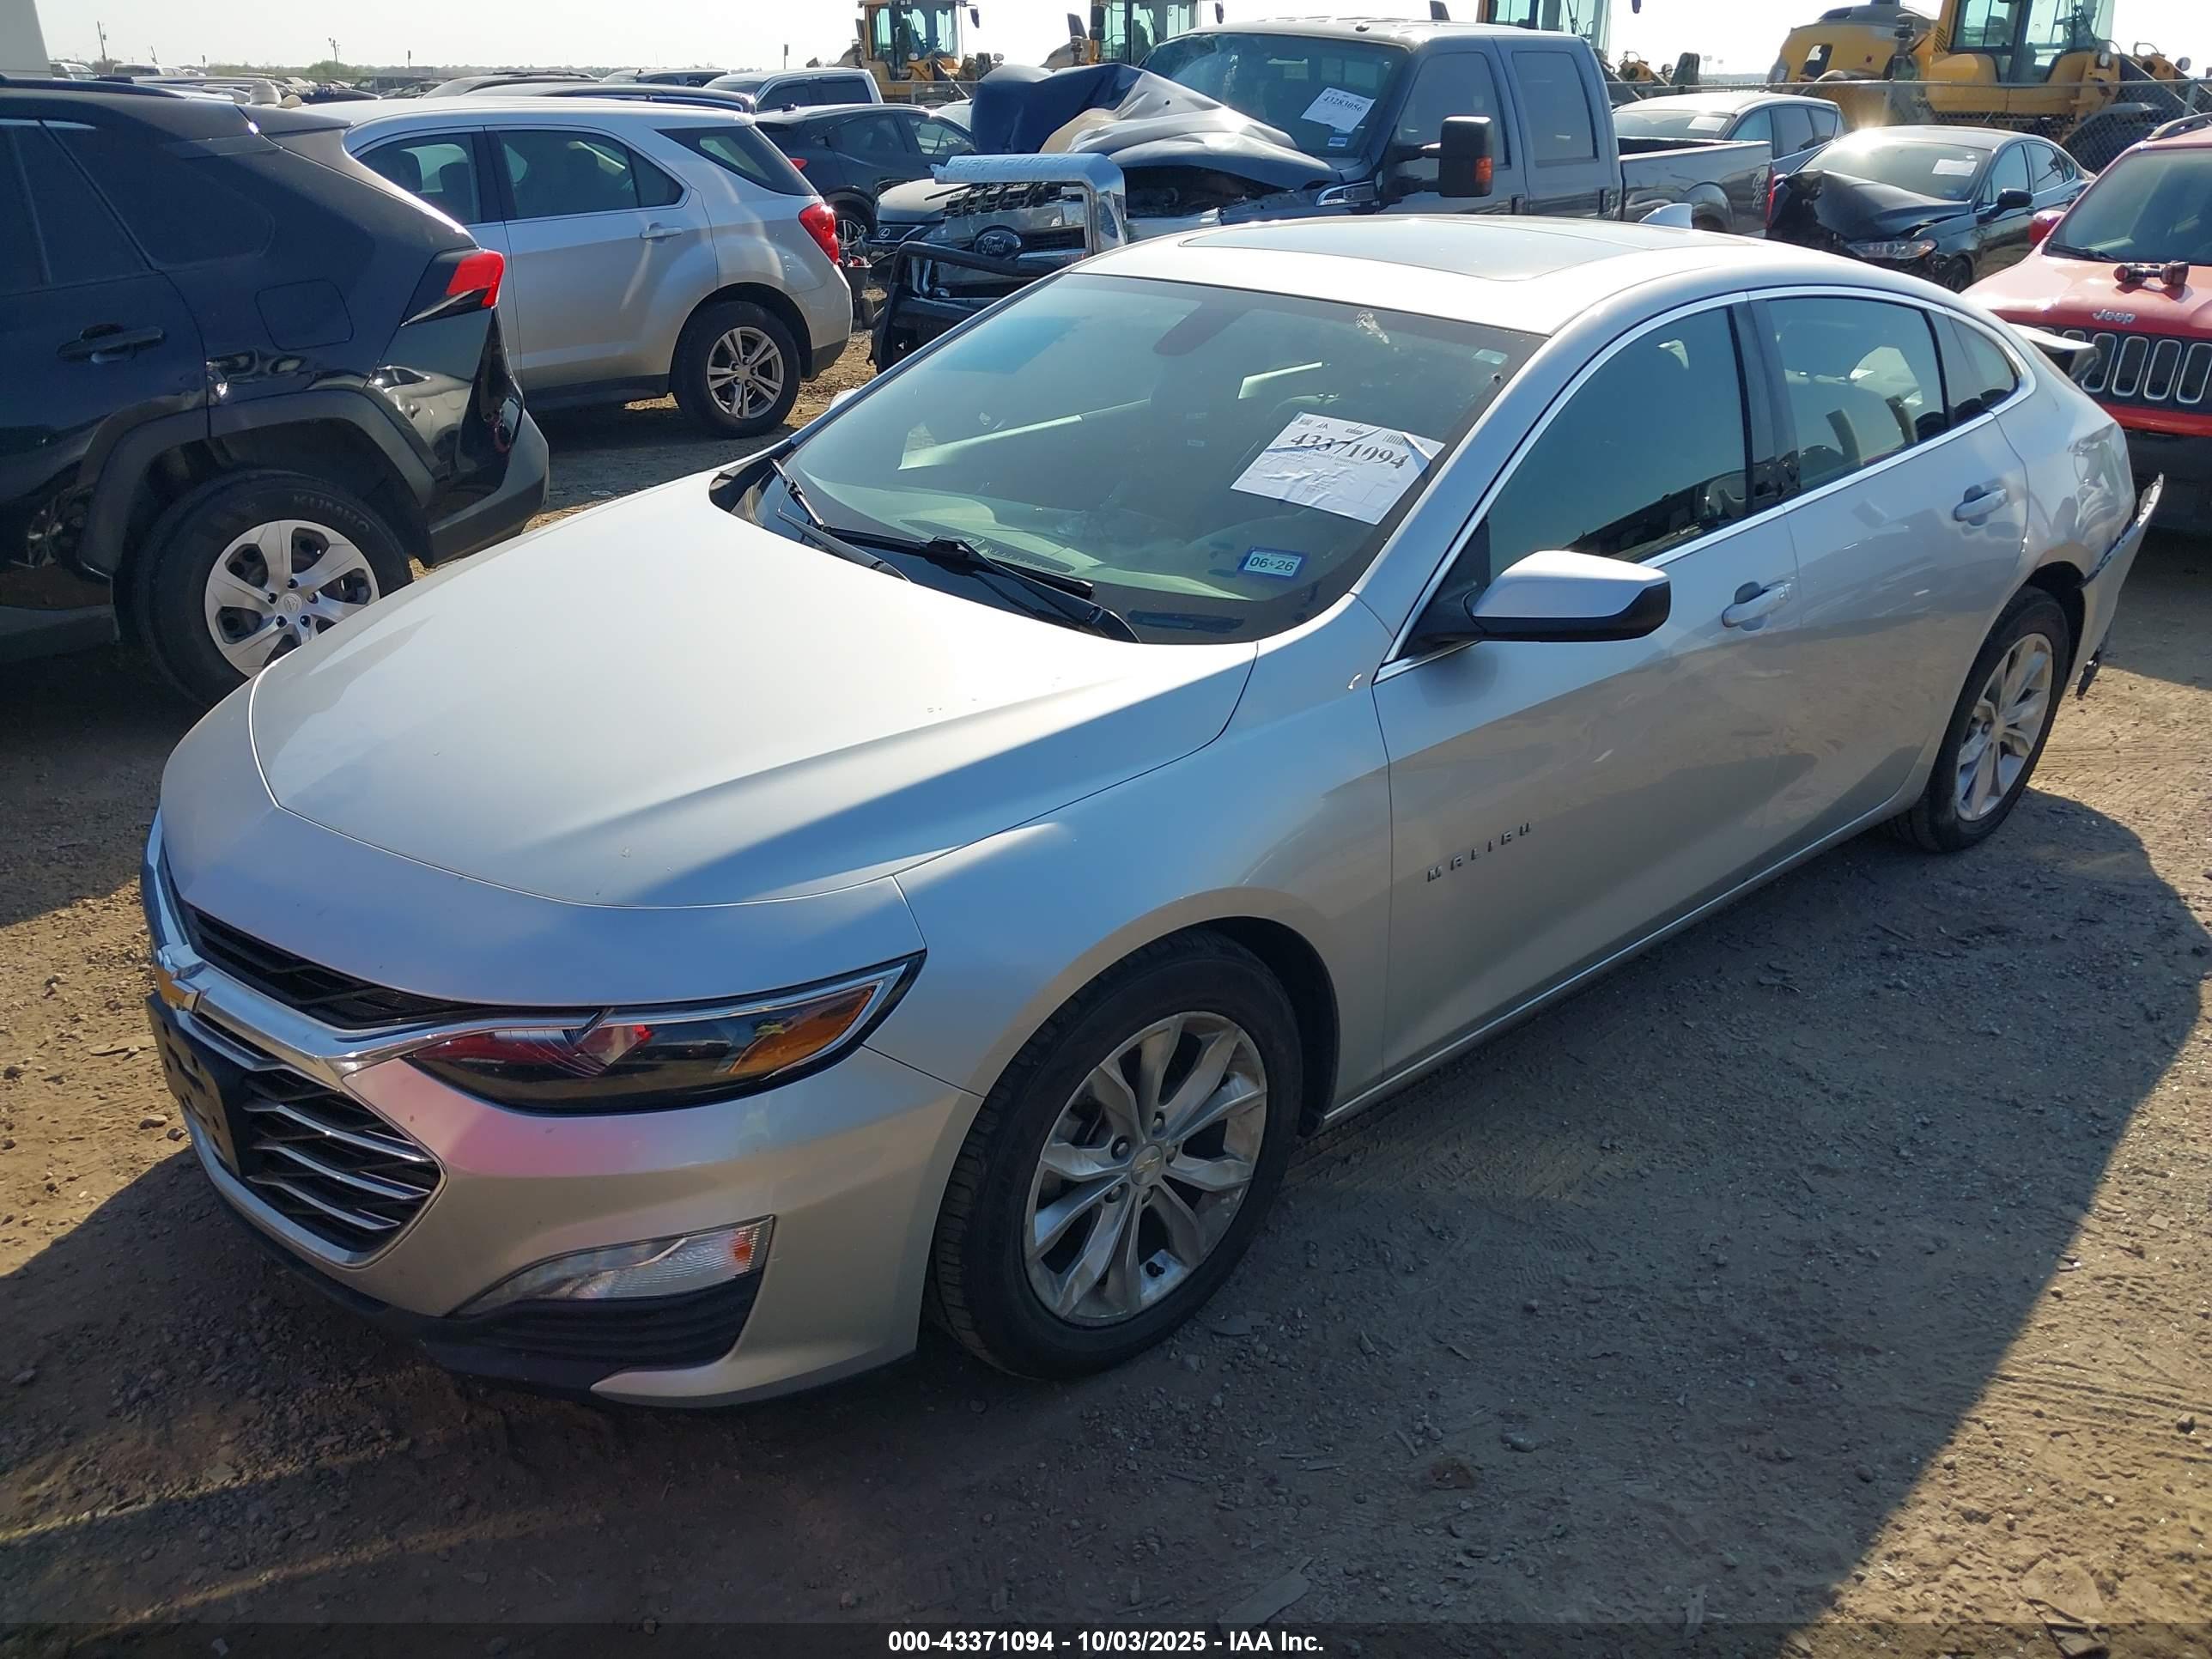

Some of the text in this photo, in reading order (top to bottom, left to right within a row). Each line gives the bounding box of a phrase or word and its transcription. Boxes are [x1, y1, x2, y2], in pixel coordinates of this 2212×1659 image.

[981, 234, 1006, 255] Ford
[2092, 308, 2136, 325] Jeep
[1291, 433, 1409, 470] 43371094
[1427, 822, 1532, 883] MALIBU
